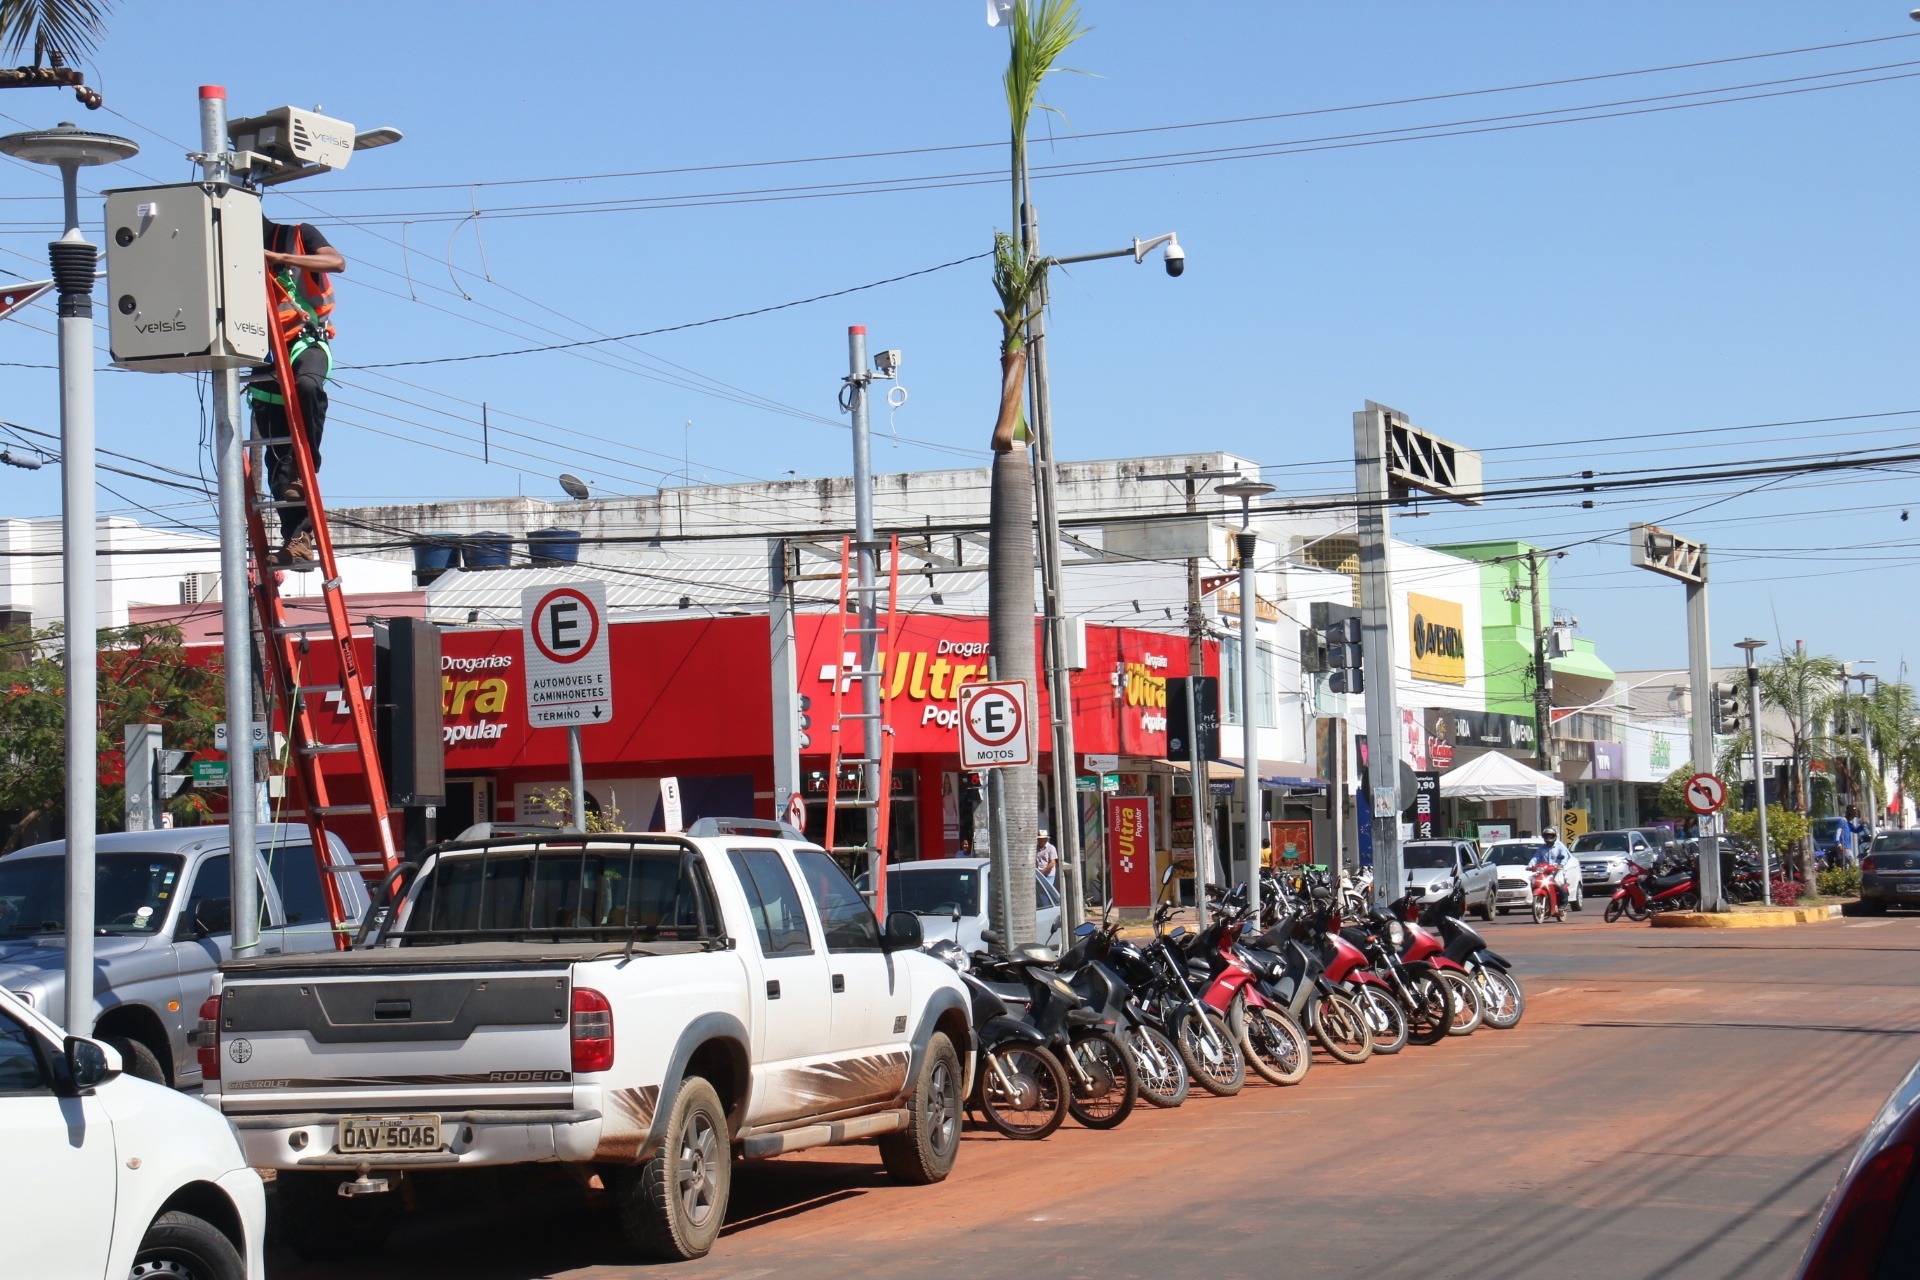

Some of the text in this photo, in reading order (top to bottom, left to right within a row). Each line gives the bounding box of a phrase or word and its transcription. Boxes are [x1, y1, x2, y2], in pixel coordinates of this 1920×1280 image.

[550, 602, 581, 650] E
[1426, 622, 1464, 660] AVENIDA
[533, 674, 603, 689] AUTOMÓVEIS E
[533, 687, 604, 702] CAMINHONETES
[537, 709, 581, 721] TÉRMINO
[985, 701, 1005, 734] E
[442, 719, 508, 746] opular
[977, 750, 1014, 760] MOTOS
[1119, 807, 1135, 856] Ultra
[1135, 808, 1143, 838] Popular
[229, 1080, 291, 1089] CHEVROLET
[489, 1071, 564, 1082] RODEIO
